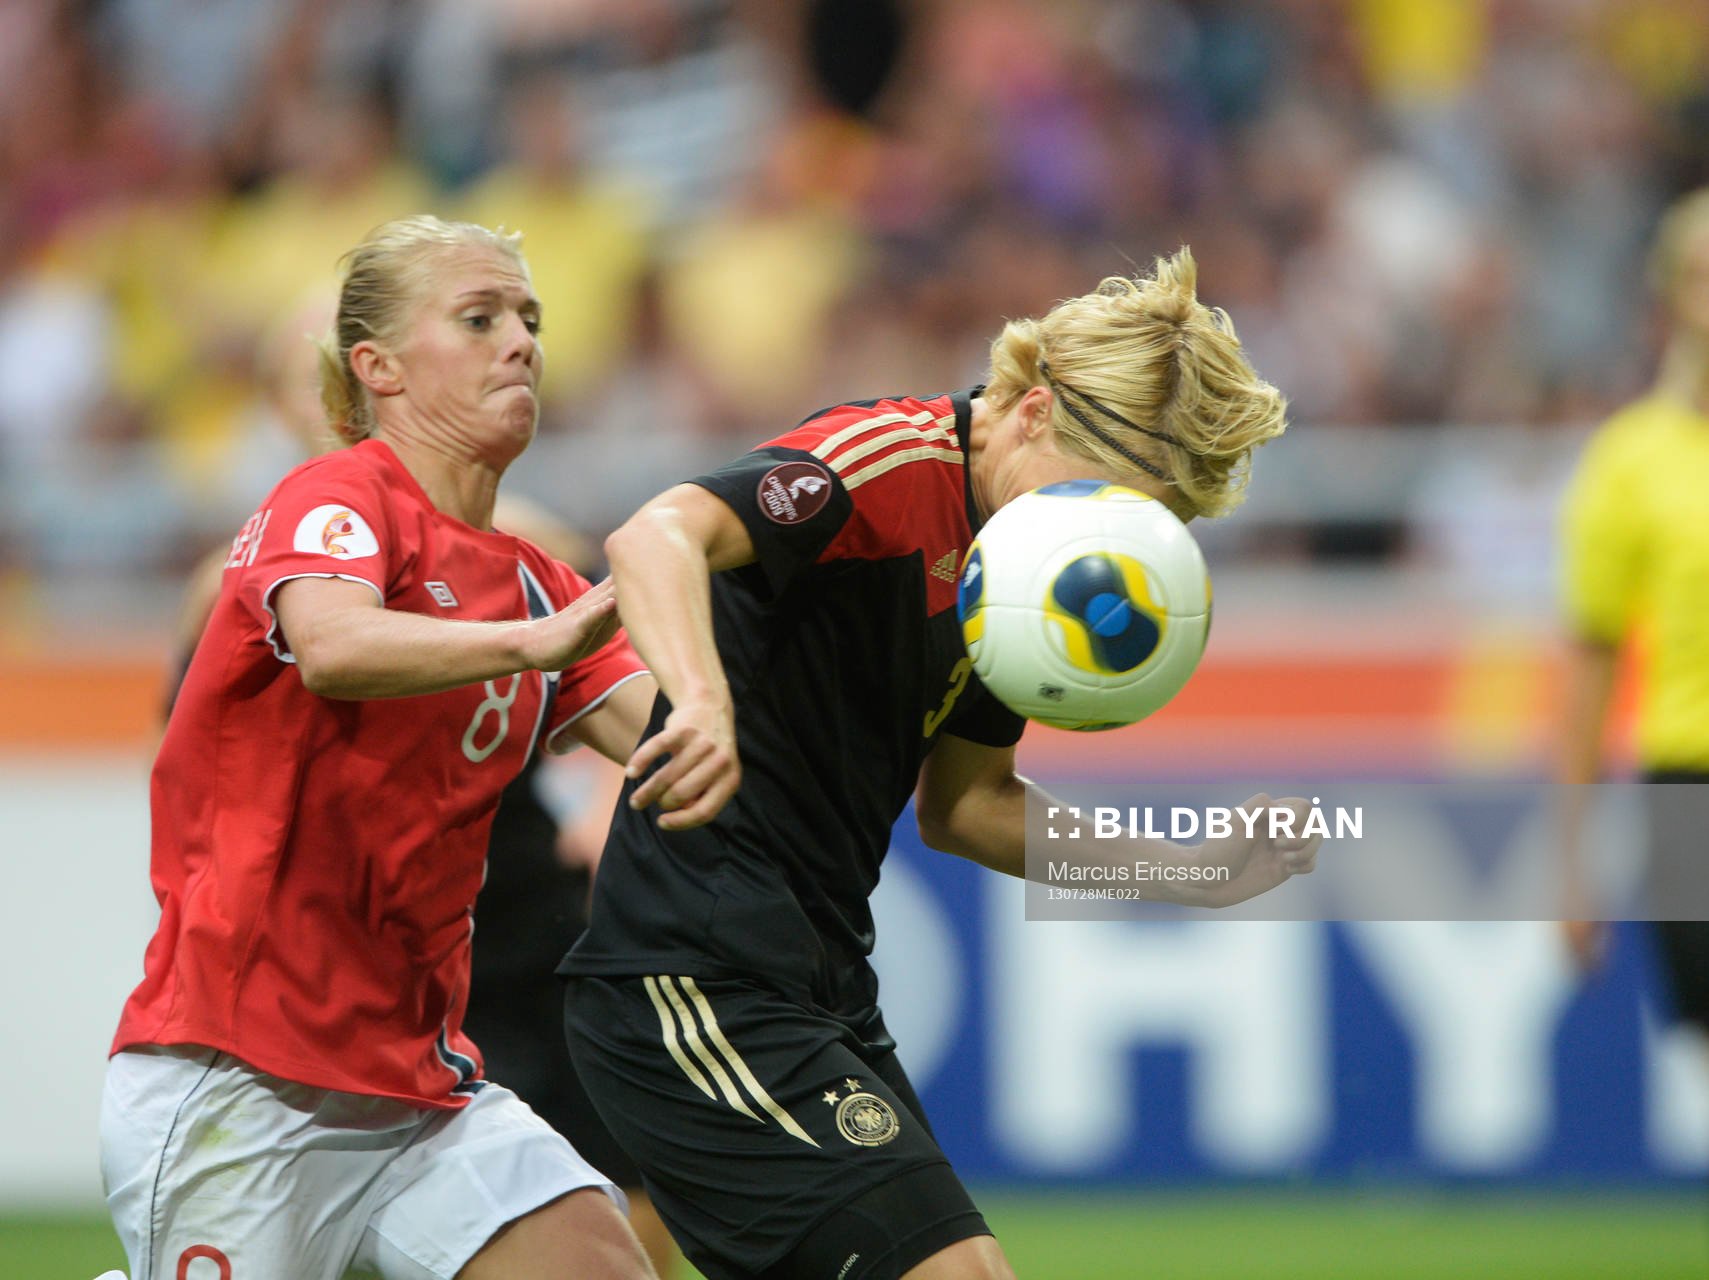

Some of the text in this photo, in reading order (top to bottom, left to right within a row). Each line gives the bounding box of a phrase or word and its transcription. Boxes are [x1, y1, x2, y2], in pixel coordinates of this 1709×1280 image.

[763, 490, 785, 516] 2009
[767, 476, 798, 520] CHAMPIONS
[461, 672, 522, 763] 8
[923, 657, 975, 738] 3
